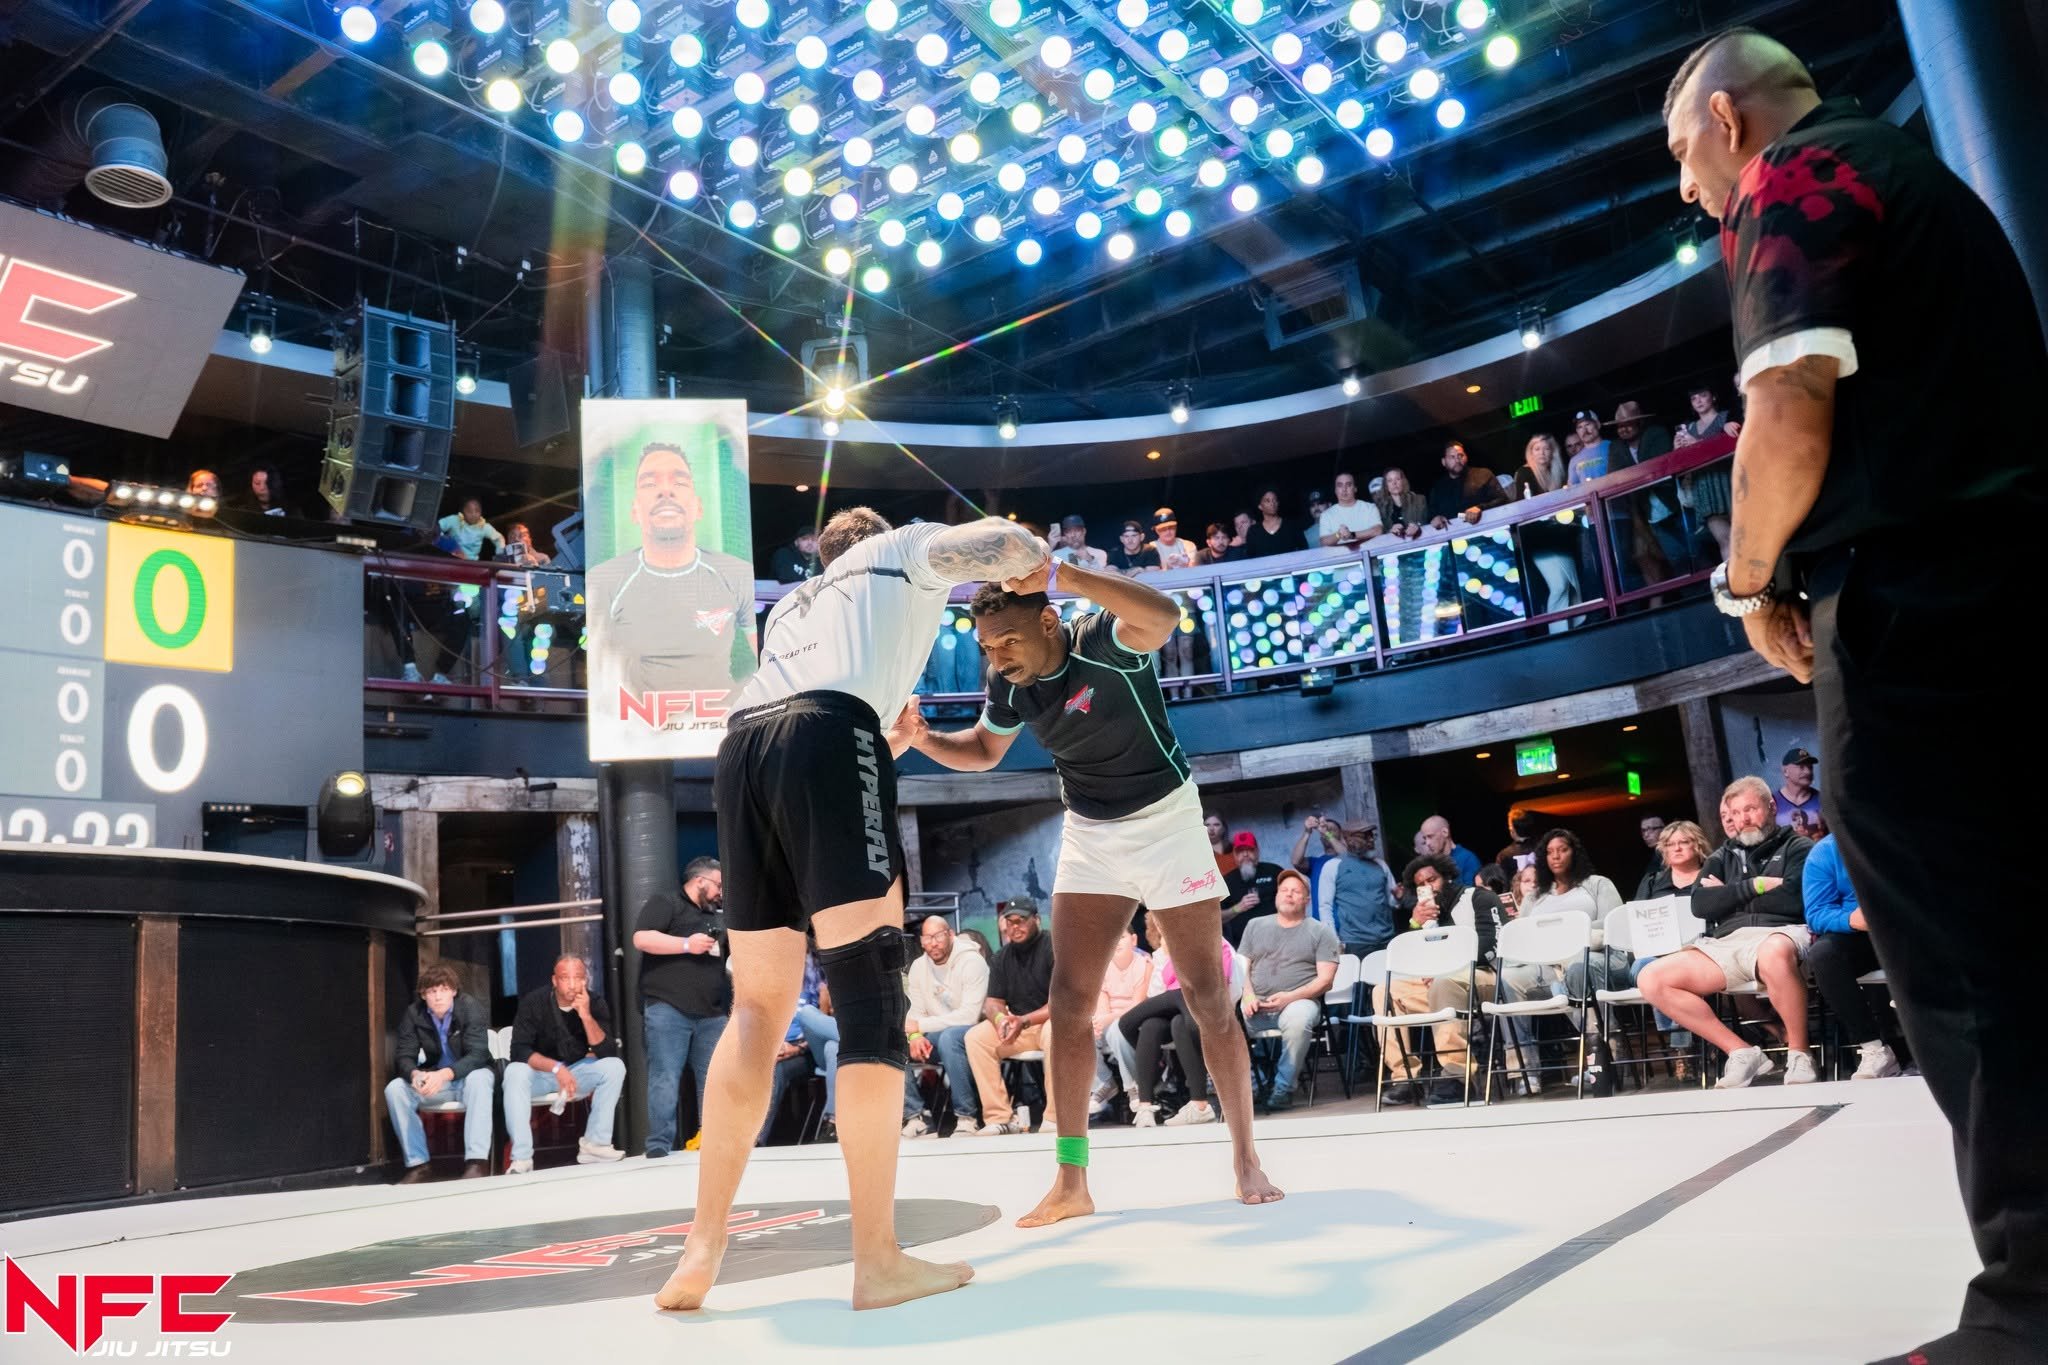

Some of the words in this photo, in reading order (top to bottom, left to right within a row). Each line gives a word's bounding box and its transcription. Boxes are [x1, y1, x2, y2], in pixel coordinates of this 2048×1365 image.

[63, 539, 94, 580] 0
[133, 549, 207, 649] 0
[60, 603, 91, 646] 0
[803, 642, 818, 653] YET
[57, 681, 90, 724] 0
[618, 684, 731, 731] NFC
[127, 684, 208, 793] 0
[663, 722, 685, 731] JIU
[55, 748, 88, 792] 0
[853, 727, 891, 882] HYPERFLY
